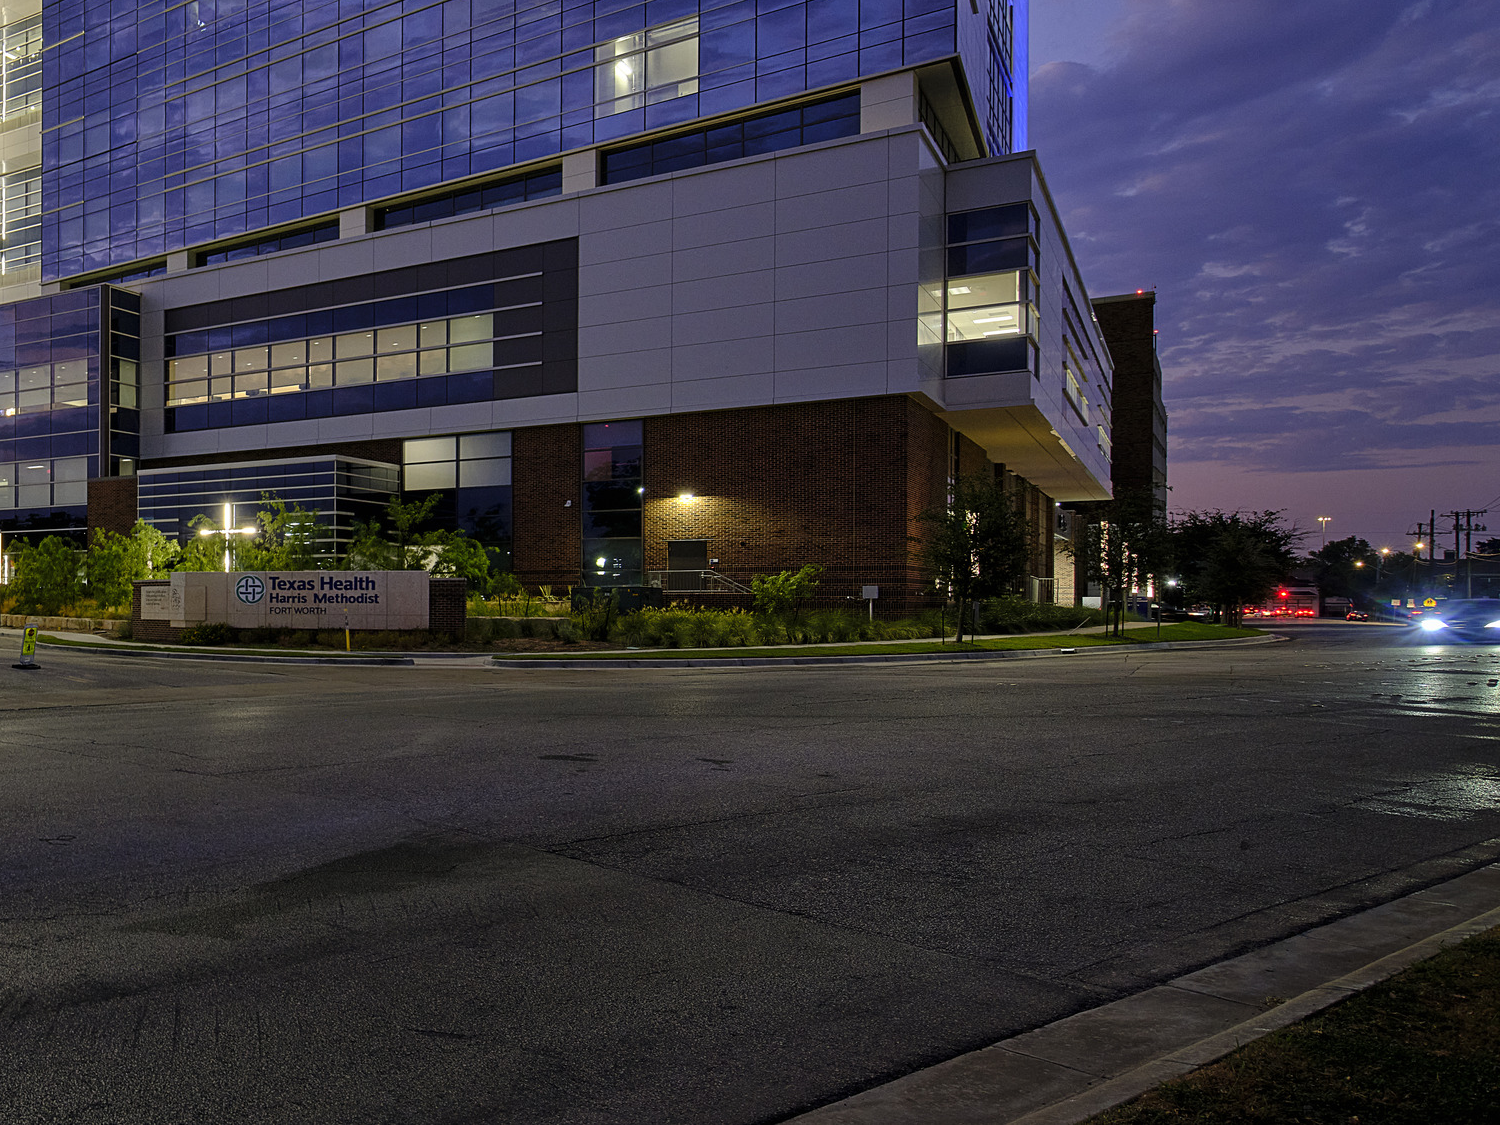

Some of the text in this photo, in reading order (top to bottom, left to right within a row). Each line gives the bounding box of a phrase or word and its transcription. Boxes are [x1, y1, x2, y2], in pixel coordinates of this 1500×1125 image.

[269, 576, 376, 591] Texas Health
[269, 593, 380, 604] Harris Methodist
[269, 607, 327, 615] FORT WORTH
